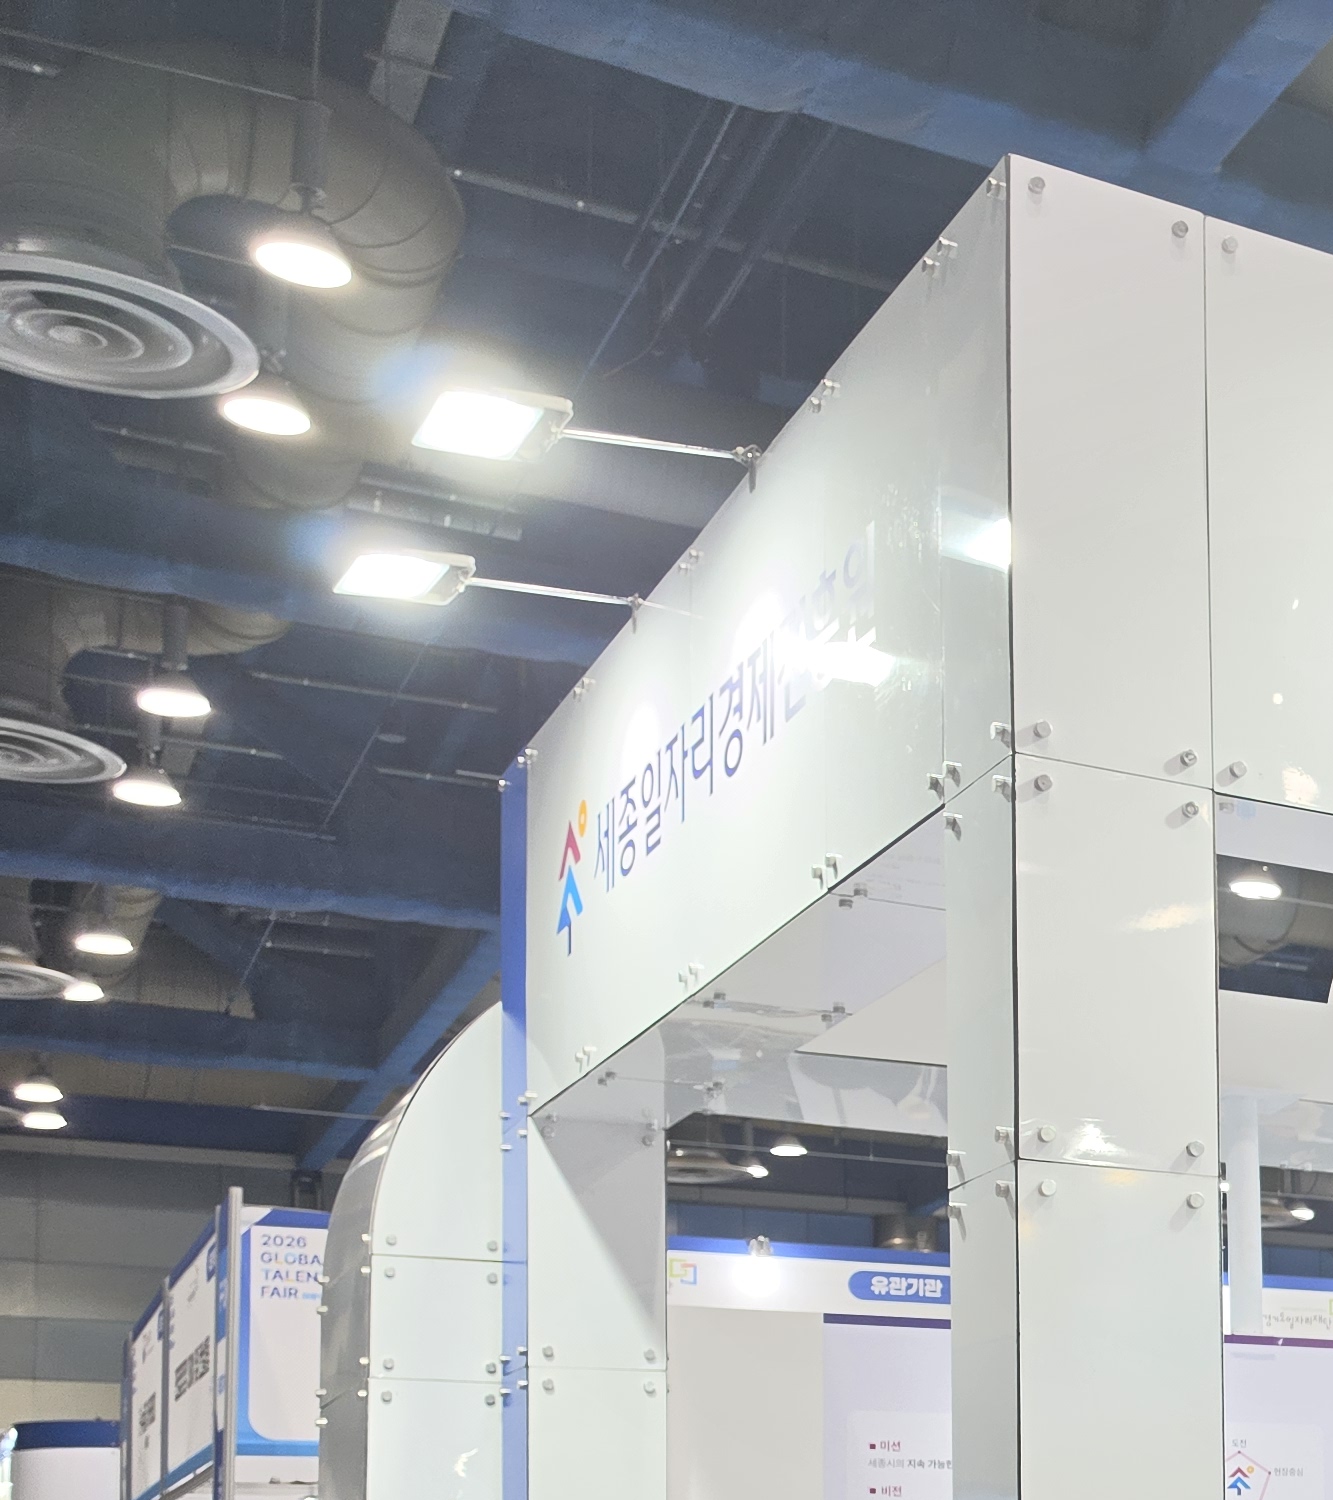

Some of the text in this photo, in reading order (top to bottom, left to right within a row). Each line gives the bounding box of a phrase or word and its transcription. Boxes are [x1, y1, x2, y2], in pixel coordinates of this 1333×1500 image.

[261, 1234, 307, 1248] 2026
[260, 1252, 322, 1266] GLOBA
[261, 1269, 319, 1282] TALEN
[260, 1286, 299, 1300] FAIR
[871, 1276, 943, 1299] 유관기관
